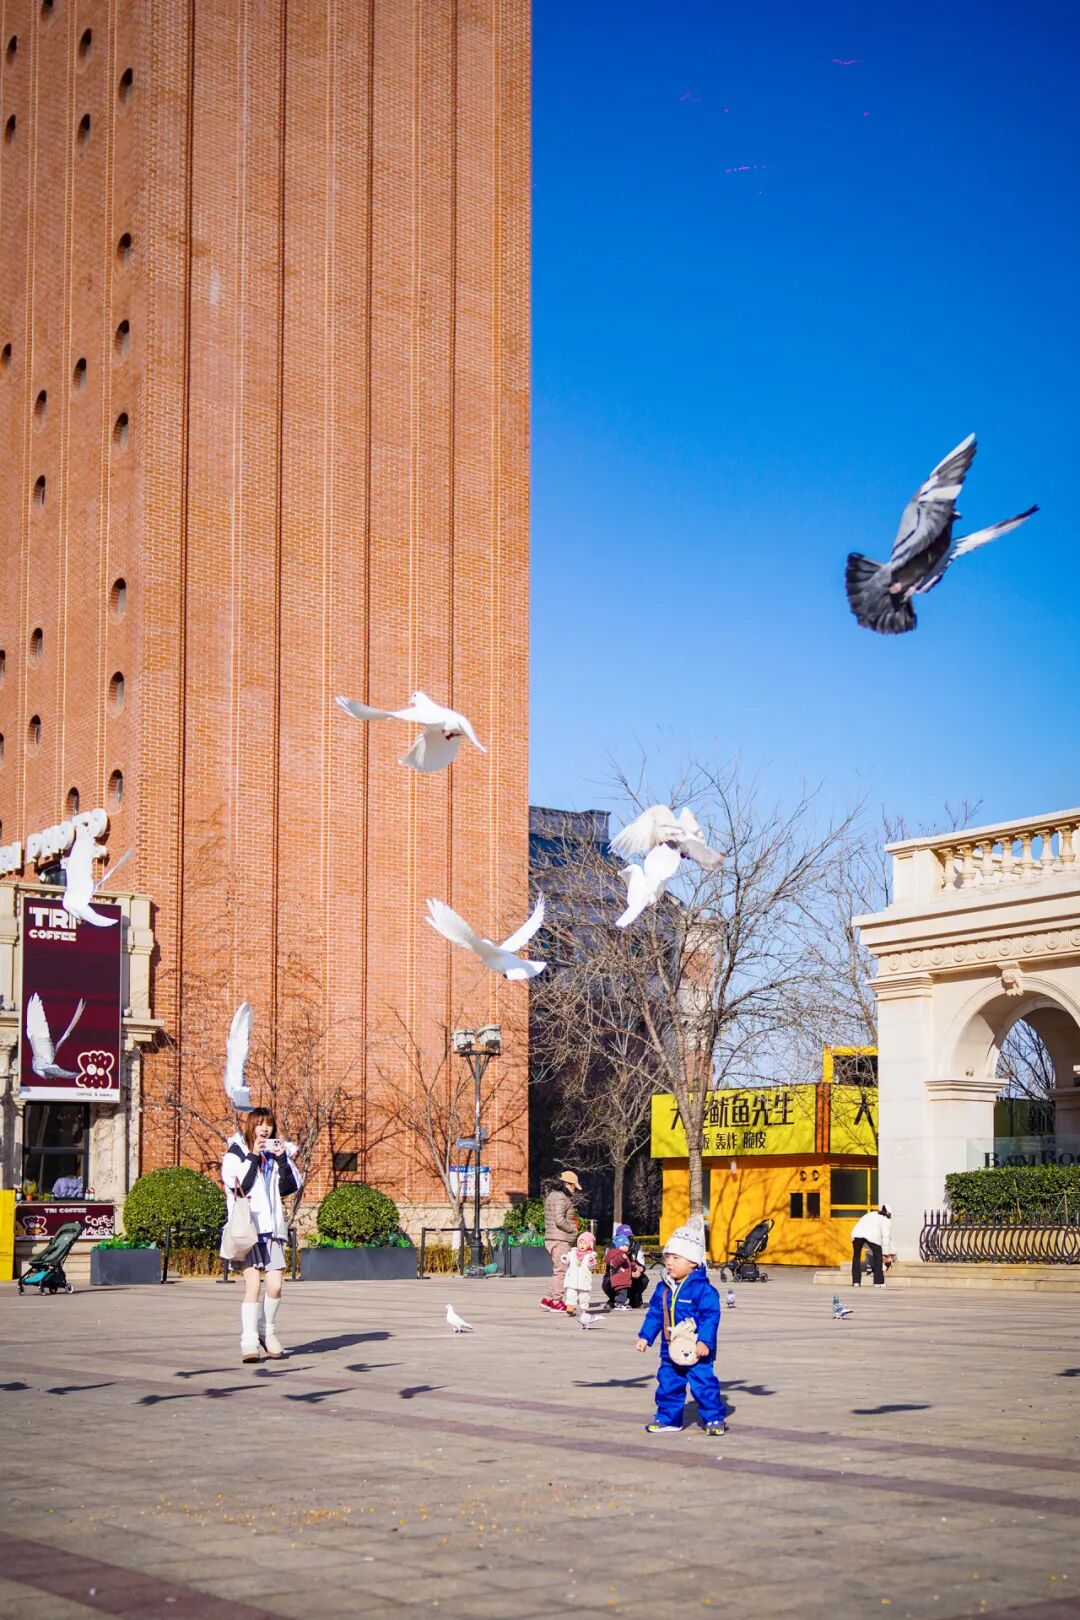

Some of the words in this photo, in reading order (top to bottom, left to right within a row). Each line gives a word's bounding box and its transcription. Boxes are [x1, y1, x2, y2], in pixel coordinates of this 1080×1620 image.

[28, 929, 77, 942] COFFEE
[670, 1091, 795, 1130] 大鱿鱼先生
[715, 1132, 738, 1150] 轰炸
[743, 1131, 766, 1149] 脆皮
